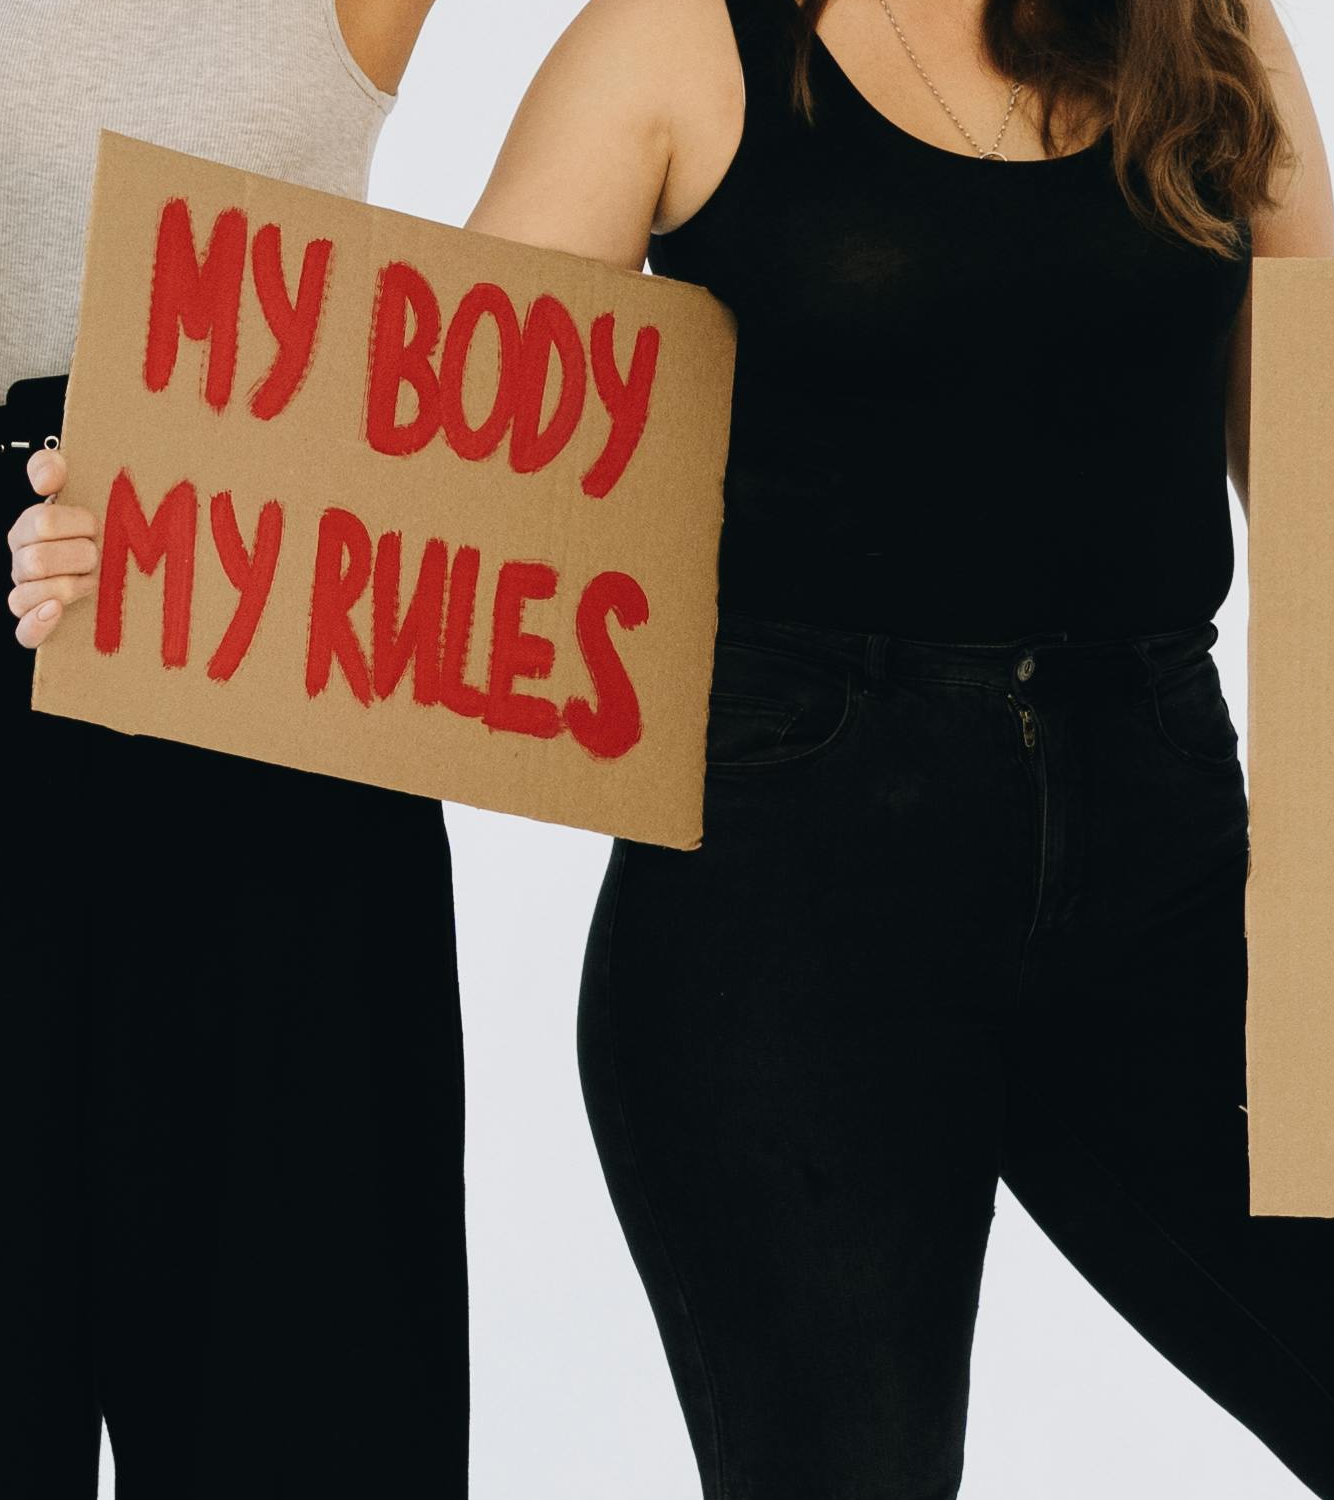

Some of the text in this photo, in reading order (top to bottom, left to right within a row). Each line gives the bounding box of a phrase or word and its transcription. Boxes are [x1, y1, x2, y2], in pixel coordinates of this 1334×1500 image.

[143, 197, 660, 499] MY BODY
[94, 468, 650, 760] MY RULES
